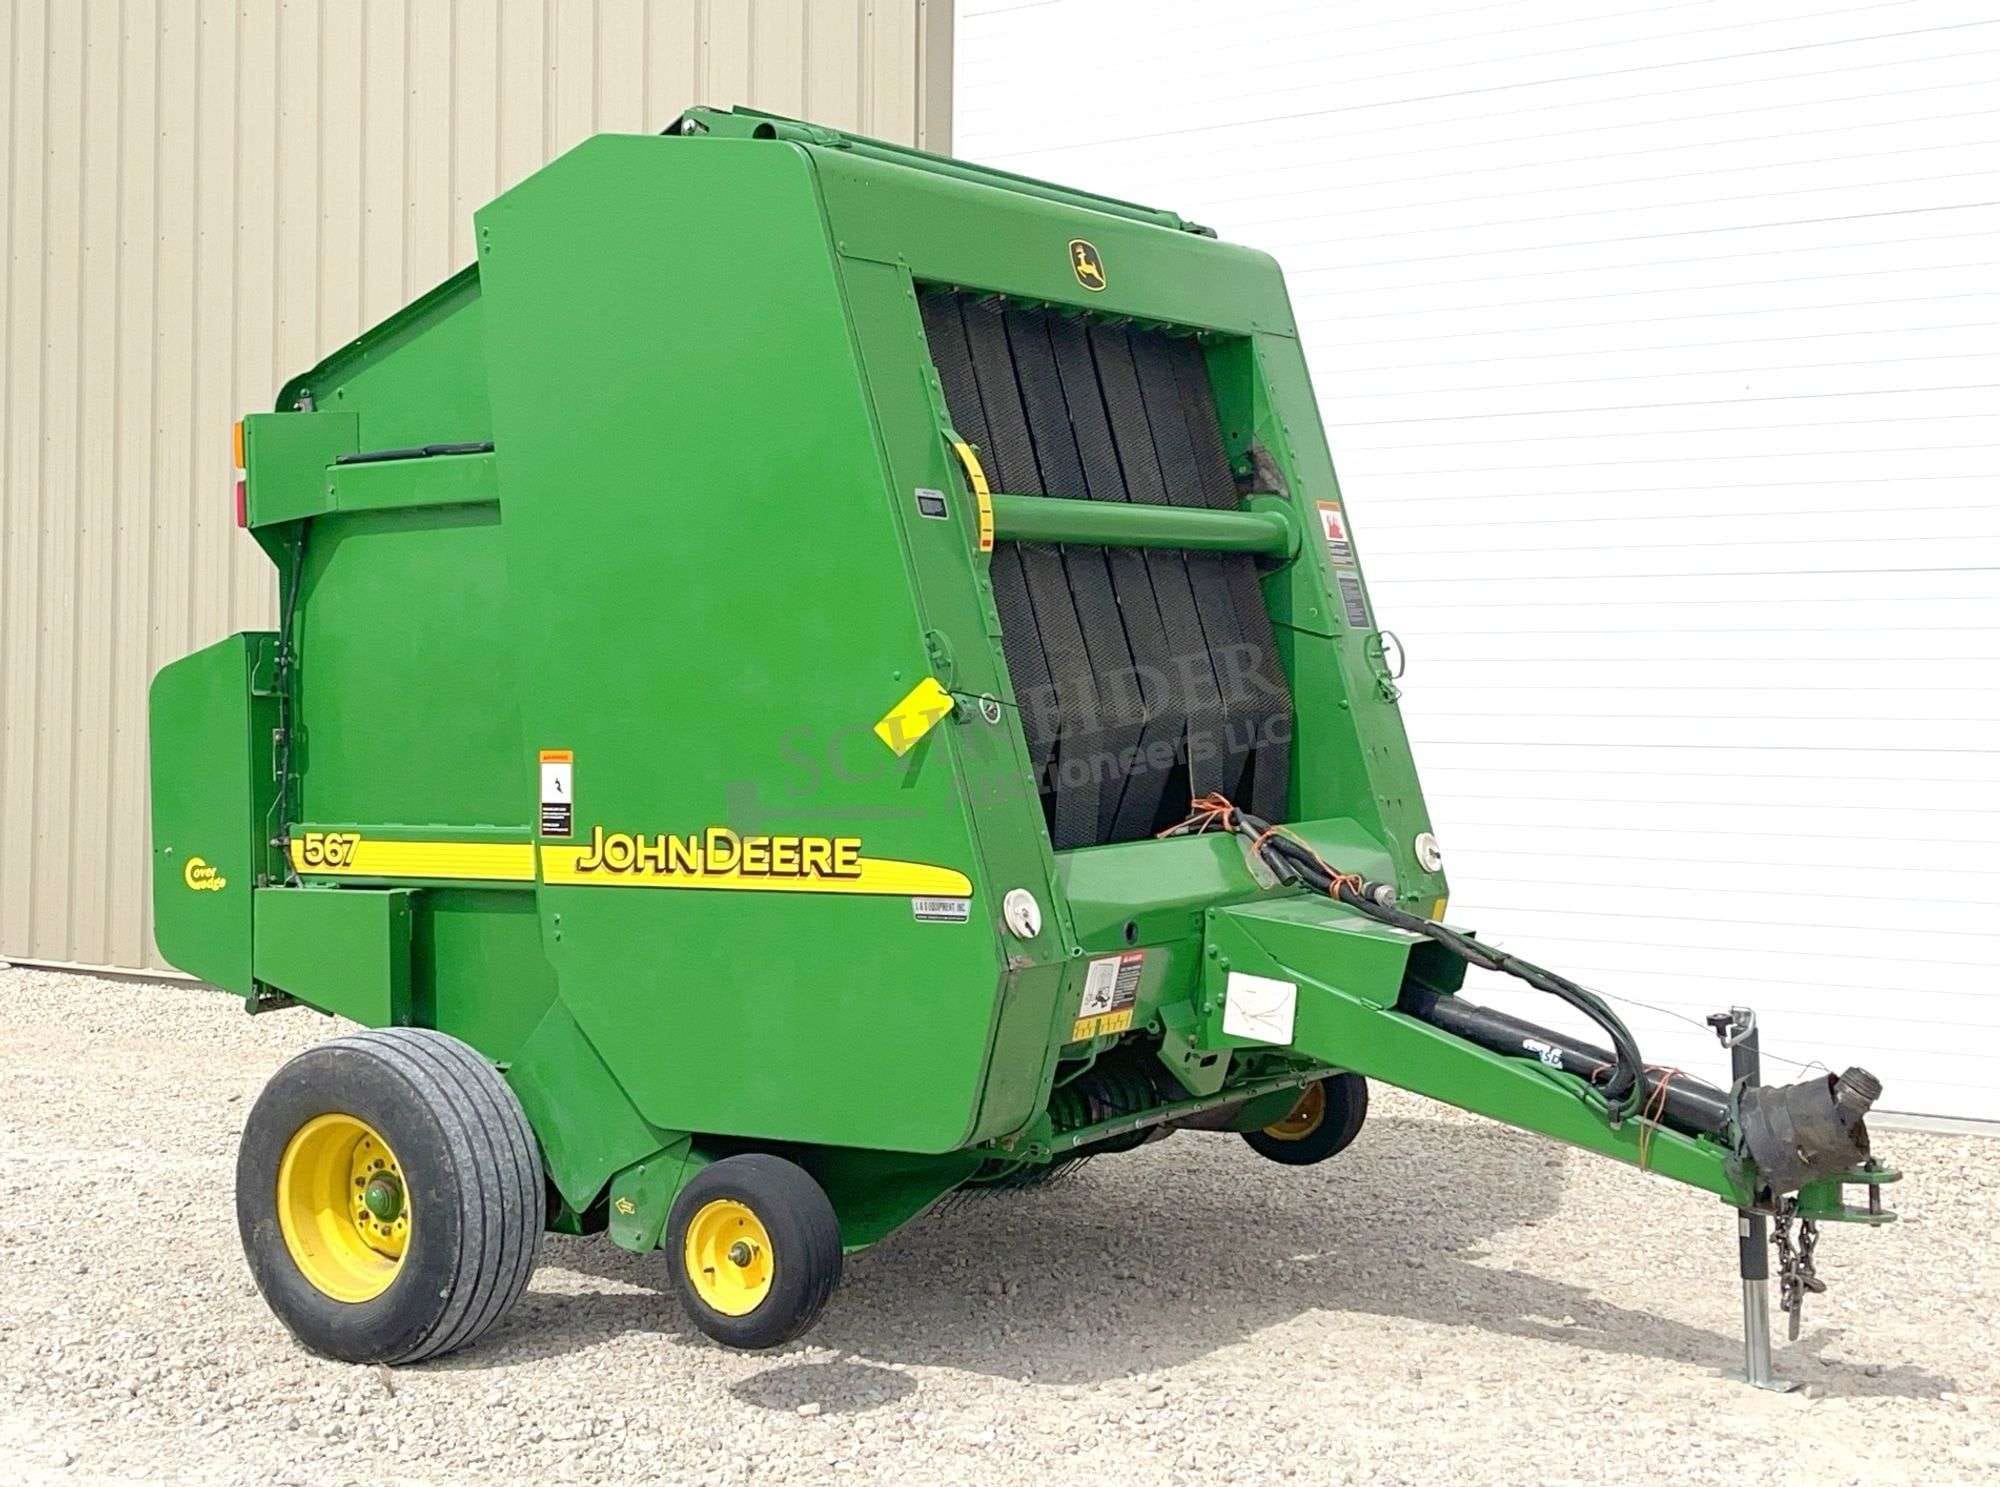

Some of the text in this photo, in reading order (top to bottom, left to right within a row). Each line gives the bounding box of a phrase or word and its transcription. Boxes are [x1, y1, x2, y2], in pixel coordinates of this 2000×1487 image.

[304, 833, 360, 866] 567
[577, 826, 862, 878] JOHN DEERE
